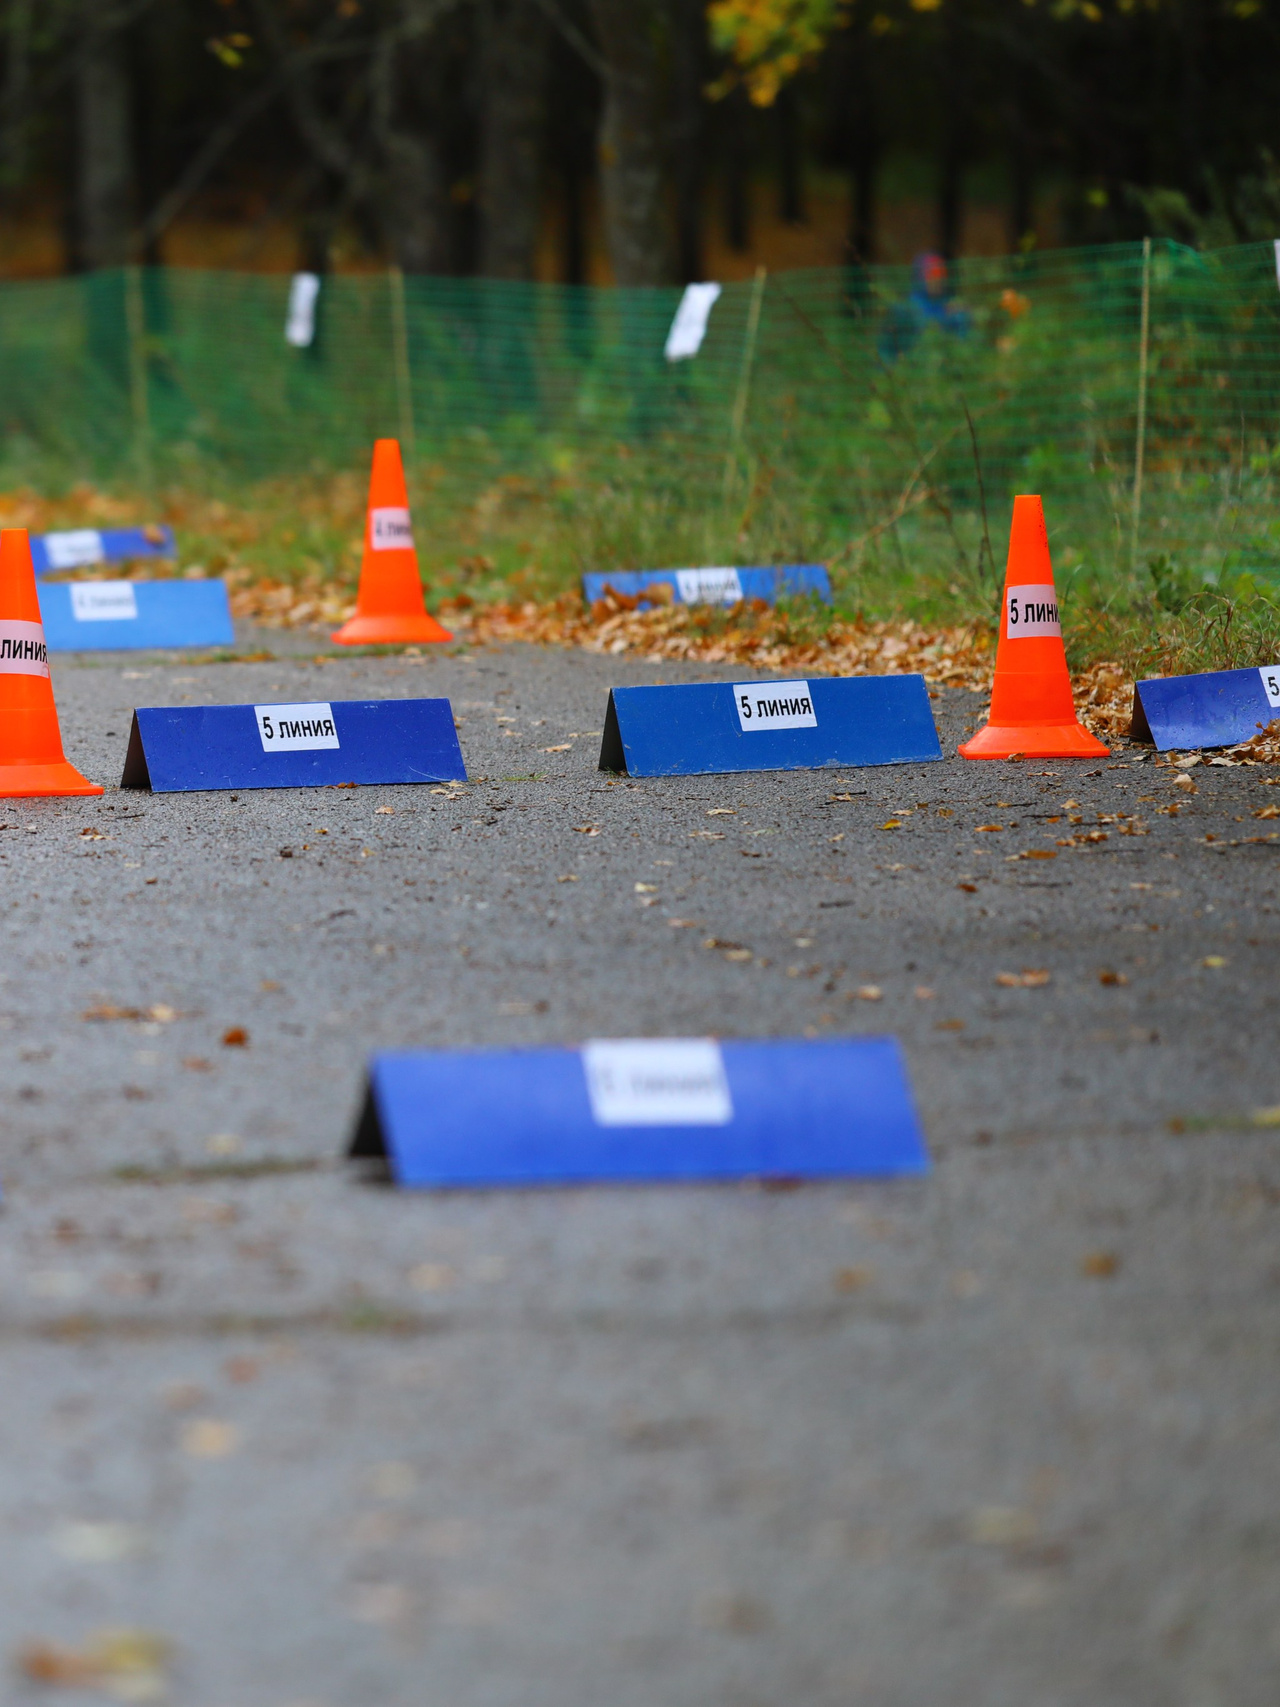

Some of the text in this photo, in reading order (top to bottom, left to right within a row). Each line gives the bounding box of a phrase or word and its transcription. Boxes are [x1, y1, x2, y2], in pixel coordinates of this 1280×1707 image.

[1010, 598, 1019, 624] 5
[0, 639, 48, 664] линия
[1267, 676, 1280, 696] 5
[740, 695, 813, 719] 5 линия
[262, 716, 335, 739] 5 линия
